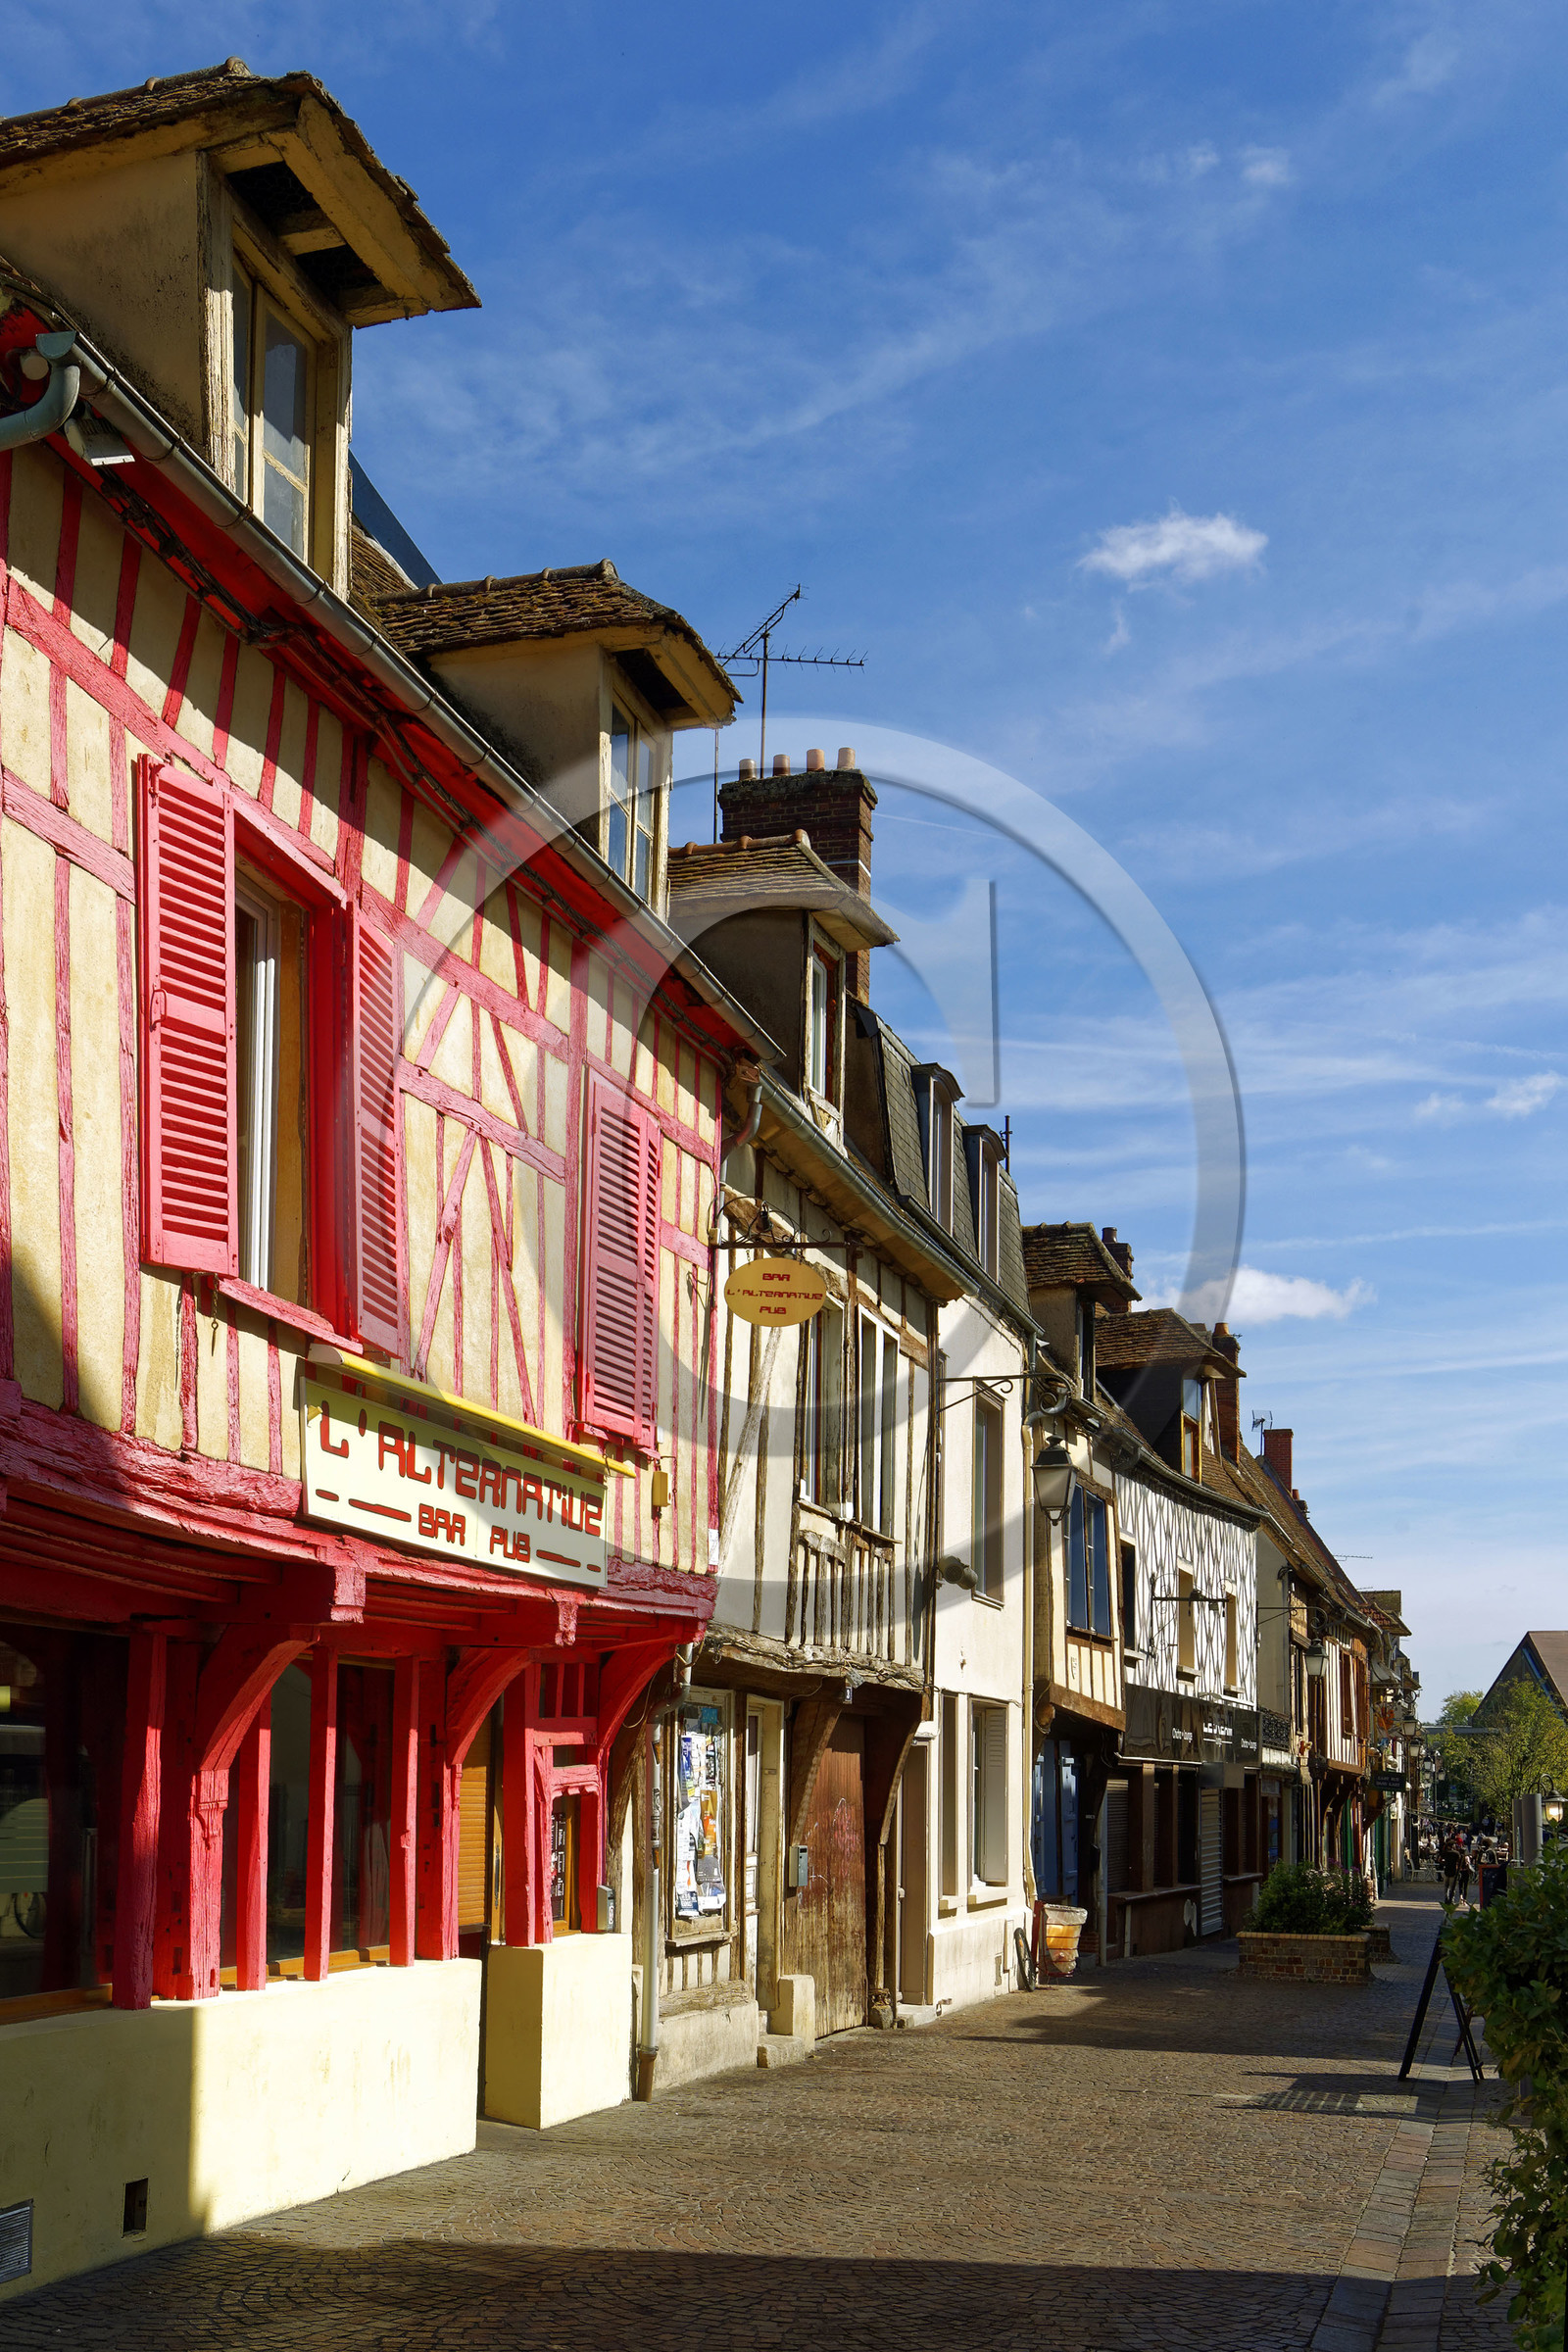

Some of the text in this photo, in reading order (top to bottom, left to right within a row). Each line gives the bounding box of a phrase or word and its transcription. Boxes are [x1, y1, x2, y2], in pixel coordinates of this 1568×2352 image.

[761, 1273, 790, 1282] BAR
[320, 1399, 604, 1538] L'ALTERNATIVE
[418, 1502, 531, 1563] BAR PUB
